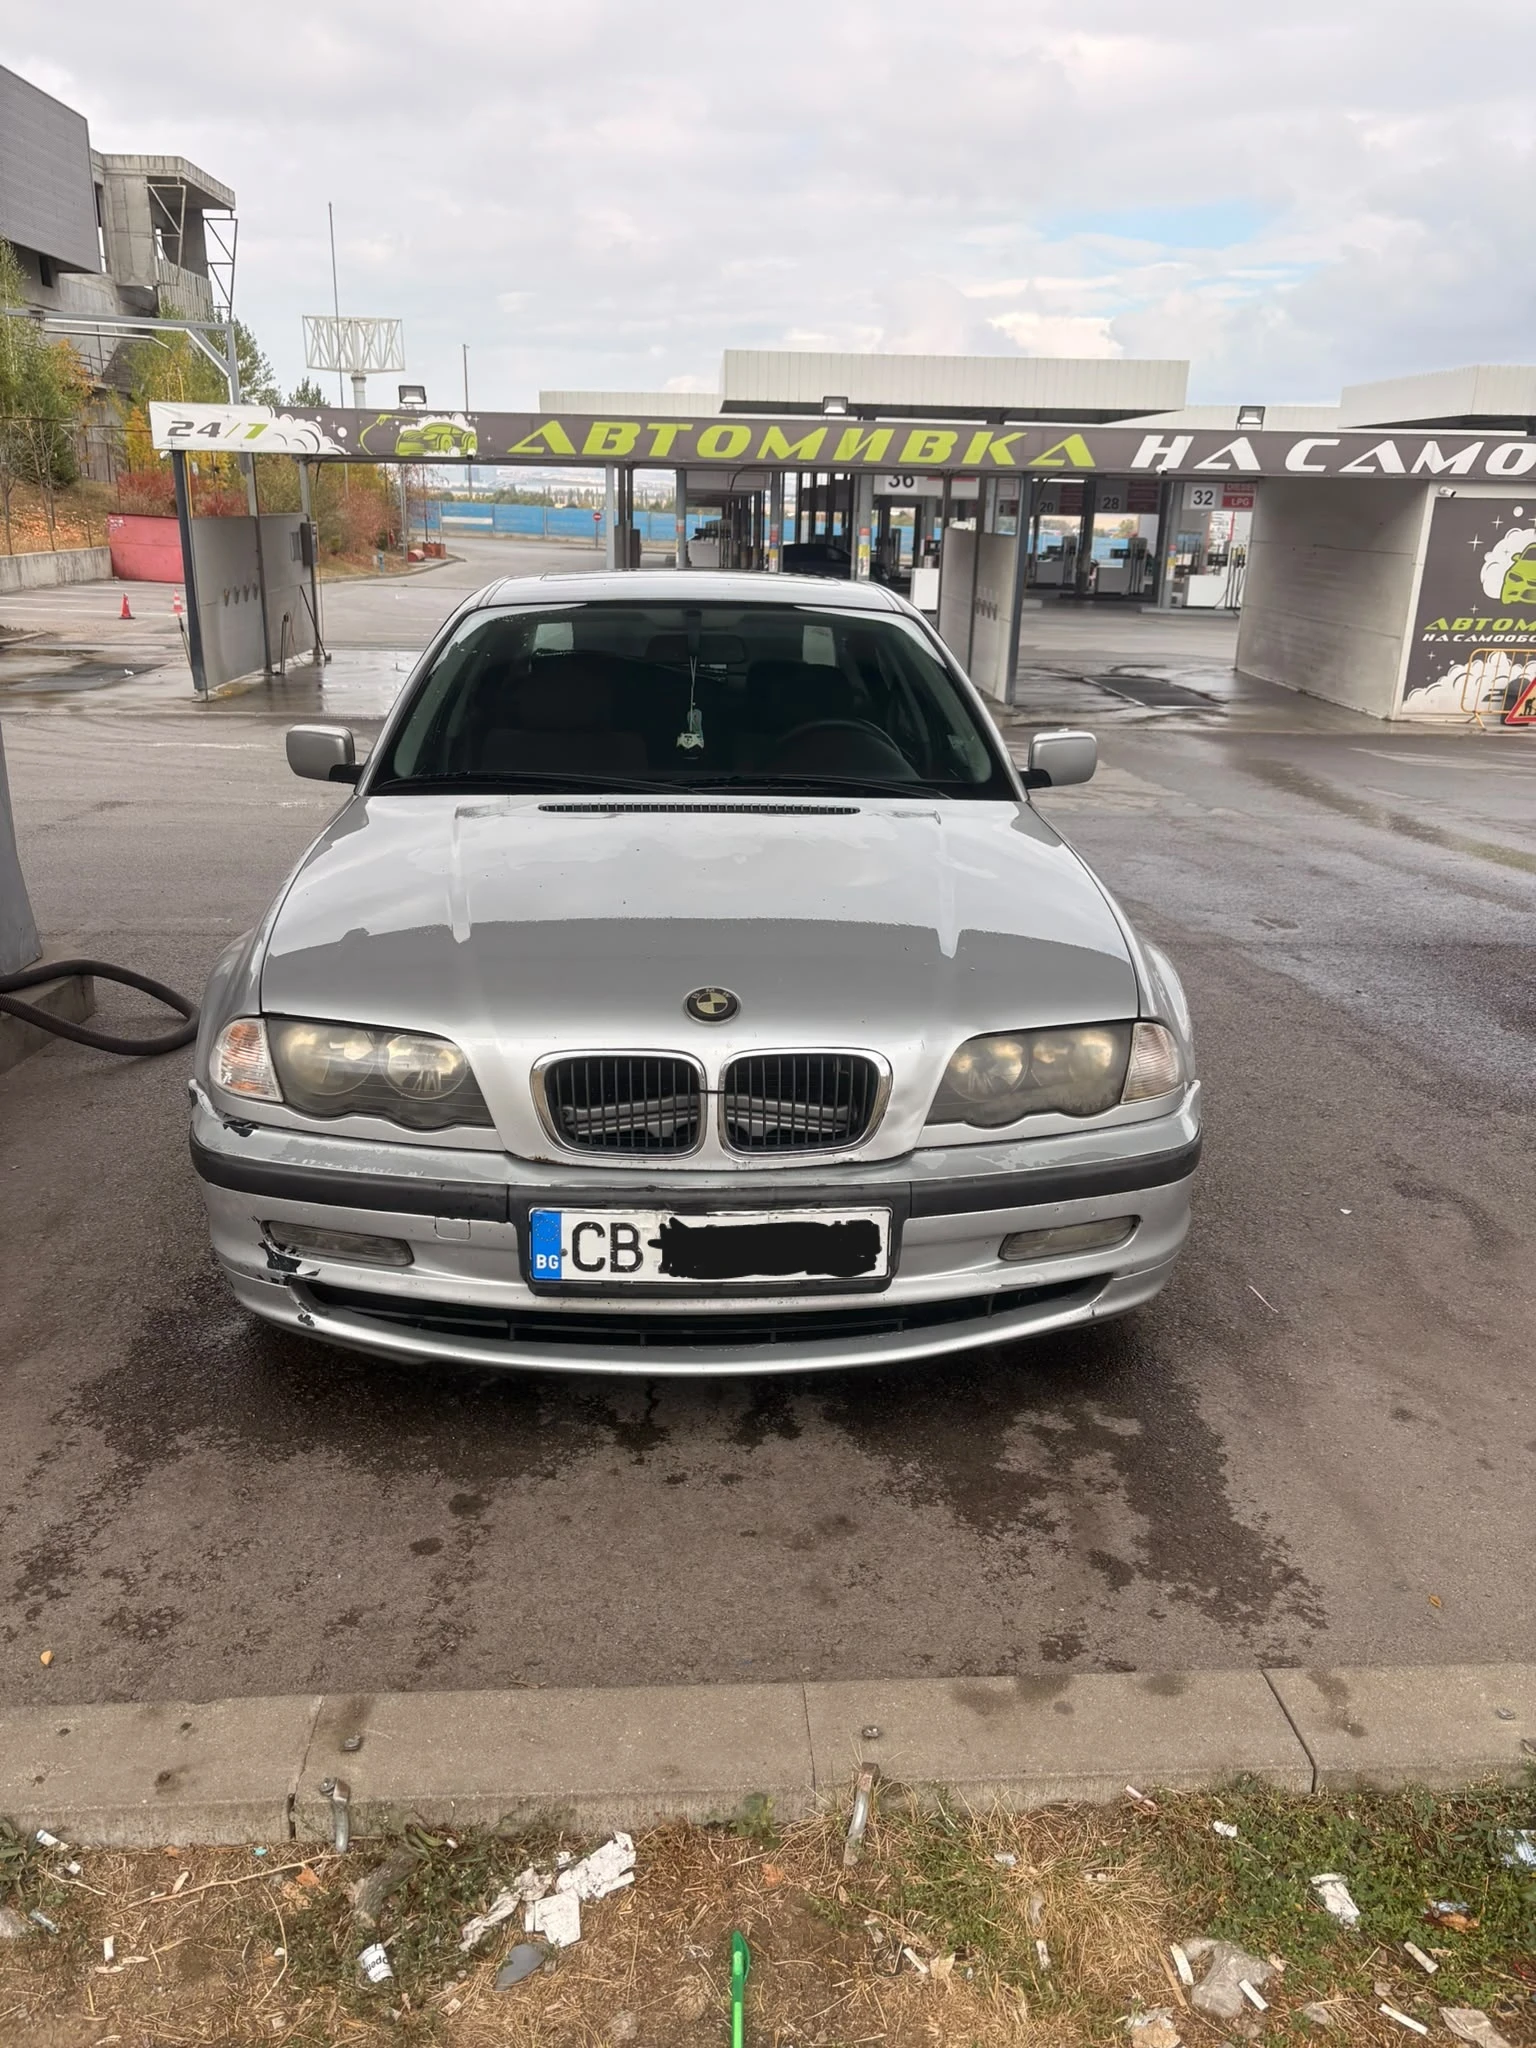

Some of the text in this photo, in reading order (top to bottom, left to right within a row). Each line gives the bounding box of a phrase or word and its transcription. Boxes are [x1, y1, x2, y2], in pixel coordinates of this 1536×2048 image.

[167, 420, 269, 440] 24/7
[507, 420, 1536, 475] АВТОМИВКА НА САМО
[1102, 497, 1119, 509] 28
[1193, 490, 1214, 505] 32
[1231, 498, 1249, 506] LPG
[1040, 502, 1054, 512] 20
[1424, 617, 1536, 631] АВТОМ
[1422, 633, 1448, 642] НА
[536, 1254, 559, 1270] BG
